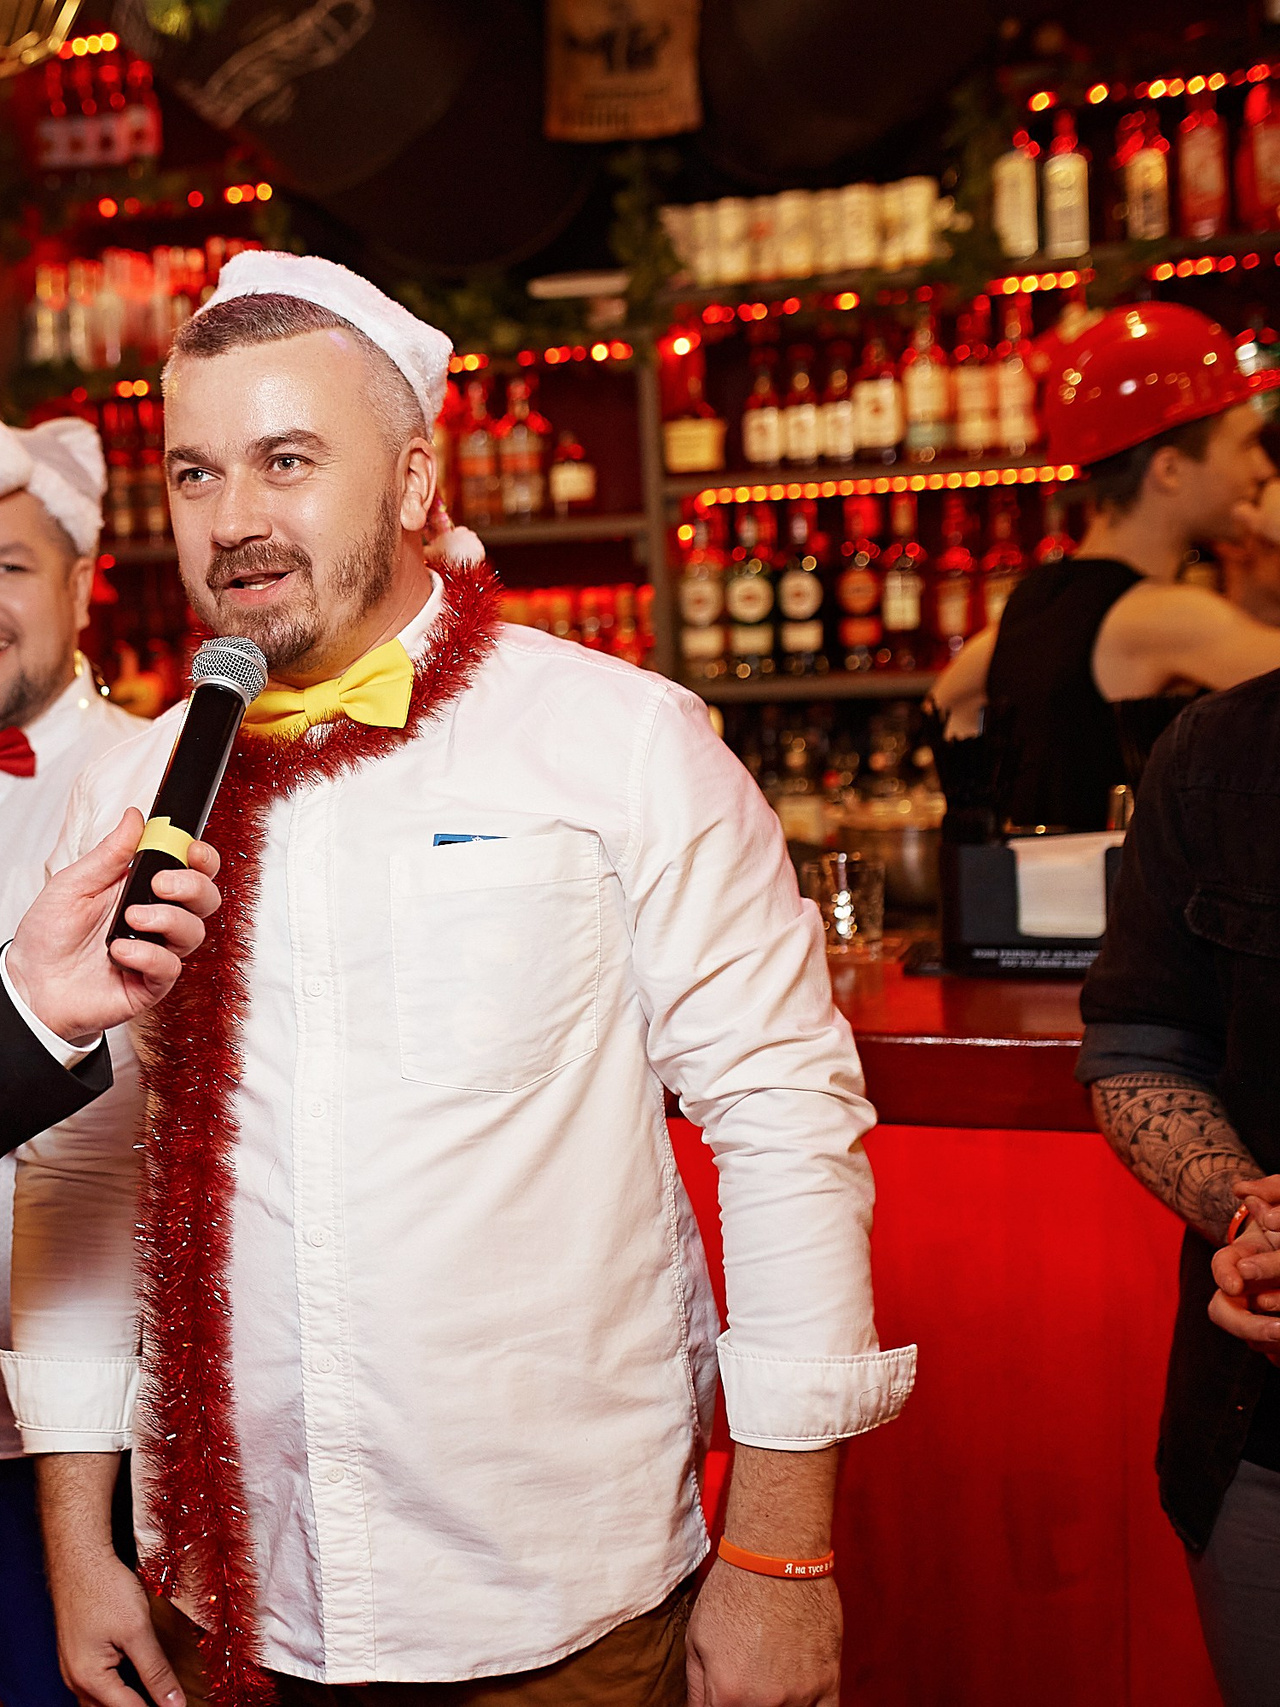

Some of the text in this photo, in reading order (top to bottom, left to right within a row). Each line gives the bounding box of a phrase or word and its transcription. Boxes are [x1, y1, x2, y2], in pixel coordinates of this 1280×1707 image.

[784, 1563, 793, 1574] Я
[795, 1566, 806, 1574] на
[808, 1564, 824, 1576] тусе
